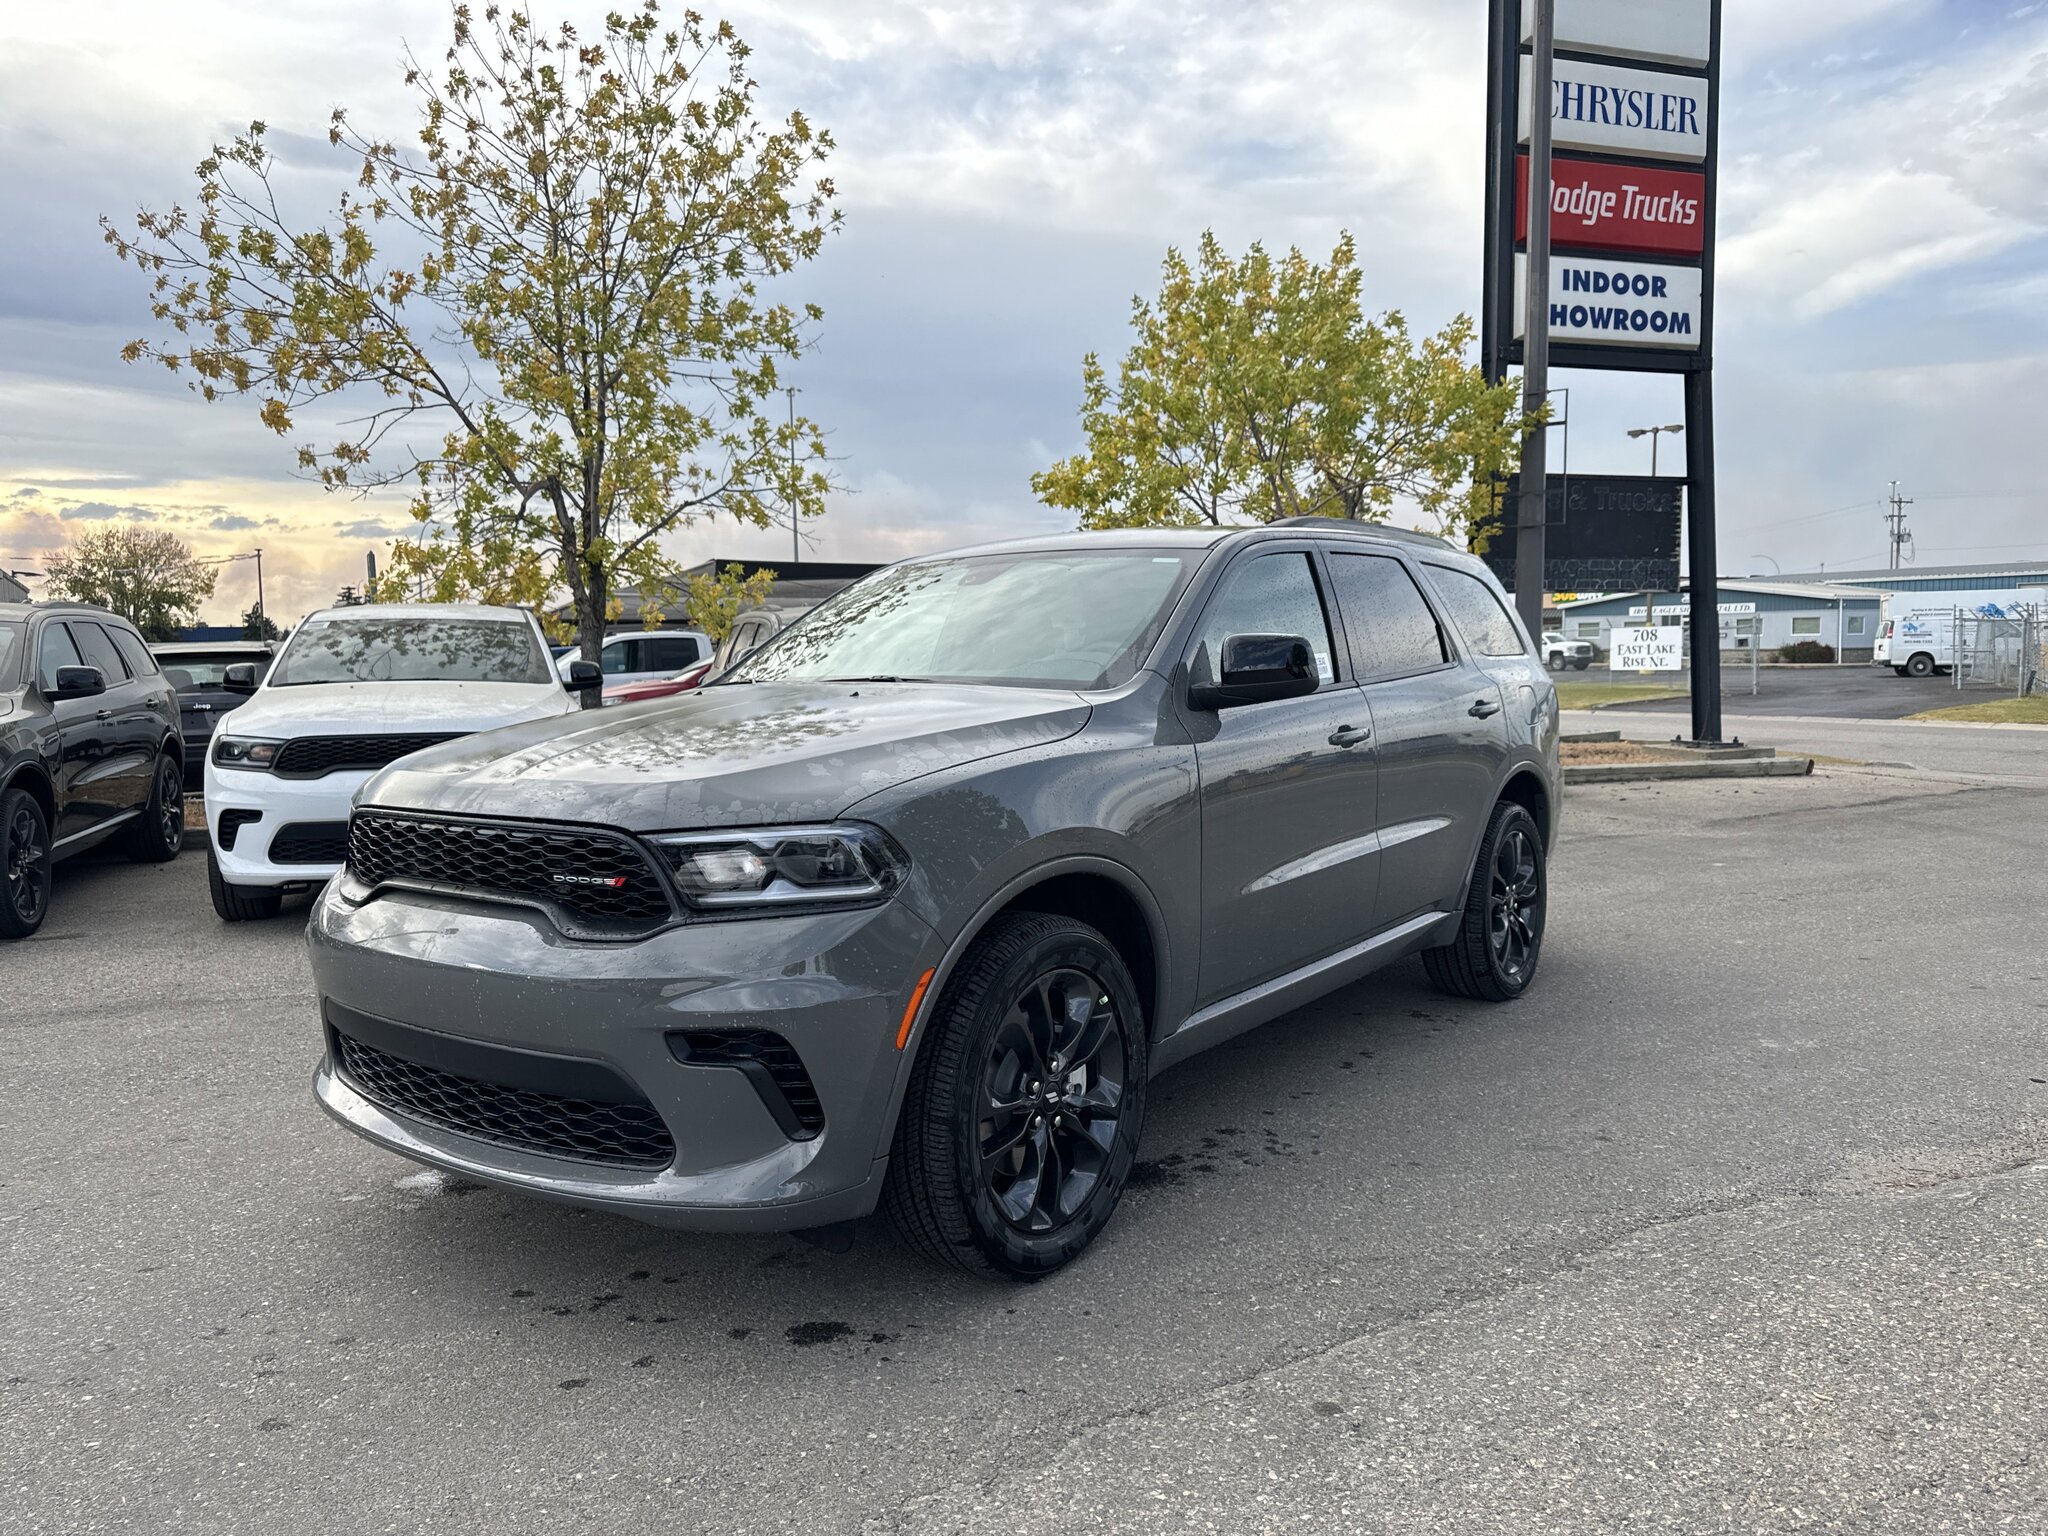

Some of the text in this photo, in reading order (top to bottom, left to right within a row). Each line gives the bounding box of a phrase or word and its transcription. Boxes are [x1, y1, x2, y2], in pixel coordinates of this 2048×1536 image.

[1550, 178, 1699, 226] odge Trucks
[1562, 268, 1668, 298] INDOOR
[1550, 303, 1692, 334] HOWROOM
[1633, 607, 1647, 615] IRO
[1653, 606, 1677, 614] EAGLE
[1633, 628, 1658, 642] 708
[1617, 643, 1676, 656] EAST LAKE
[193, 702, 211, 710] Jeep
[553, 875, 617, 886] DODGE
